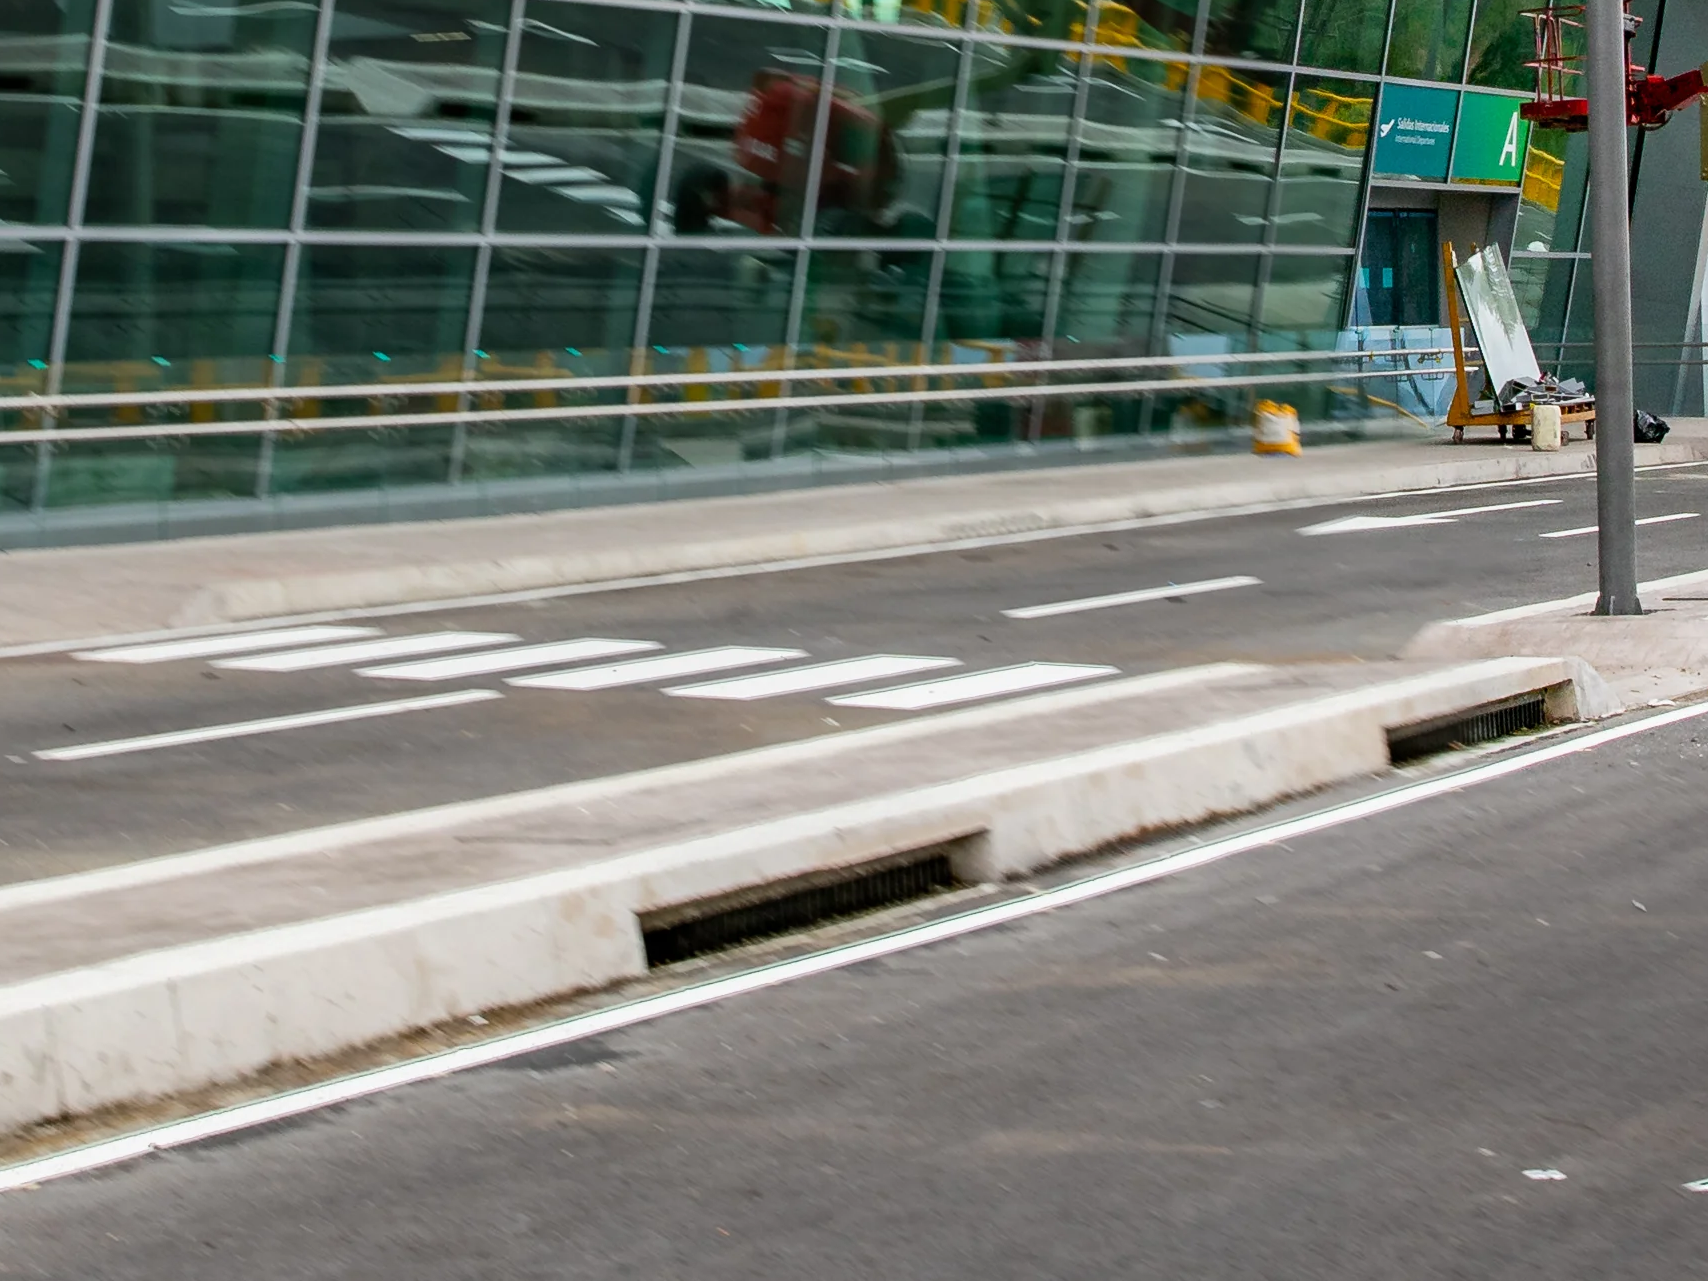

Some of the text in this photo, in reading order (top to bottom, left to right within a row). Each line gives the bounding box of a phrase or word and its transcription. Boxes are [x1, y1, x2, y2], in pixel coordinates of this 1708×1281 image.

[1397, 117, 1449, 133] Salidas Internacionales
[1498, 111, 1518, 167] A
